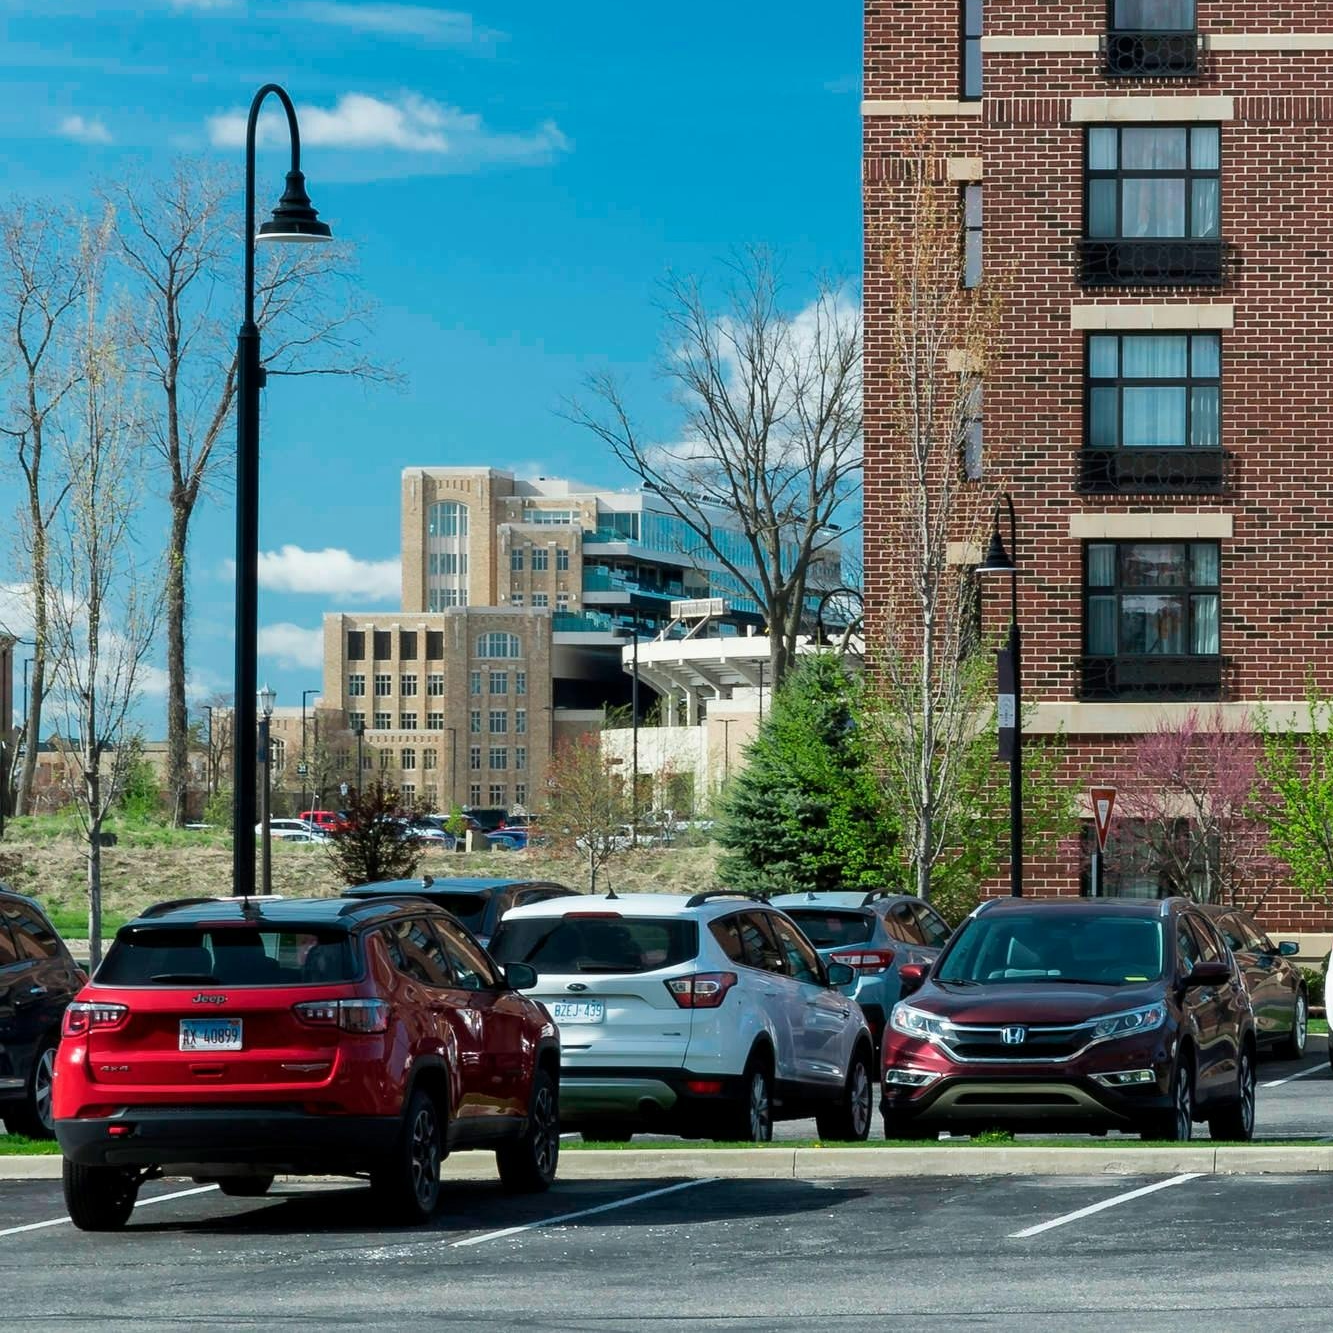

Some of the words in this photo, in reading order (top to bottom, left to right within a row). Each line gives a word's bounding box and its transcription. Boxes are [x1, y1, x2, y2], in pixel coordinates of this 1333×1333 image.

[192, 993, 227, 1006] Jeep
[183, 1029, 197, 1045] AX
[204, 1028, 239, 1043] 40899
